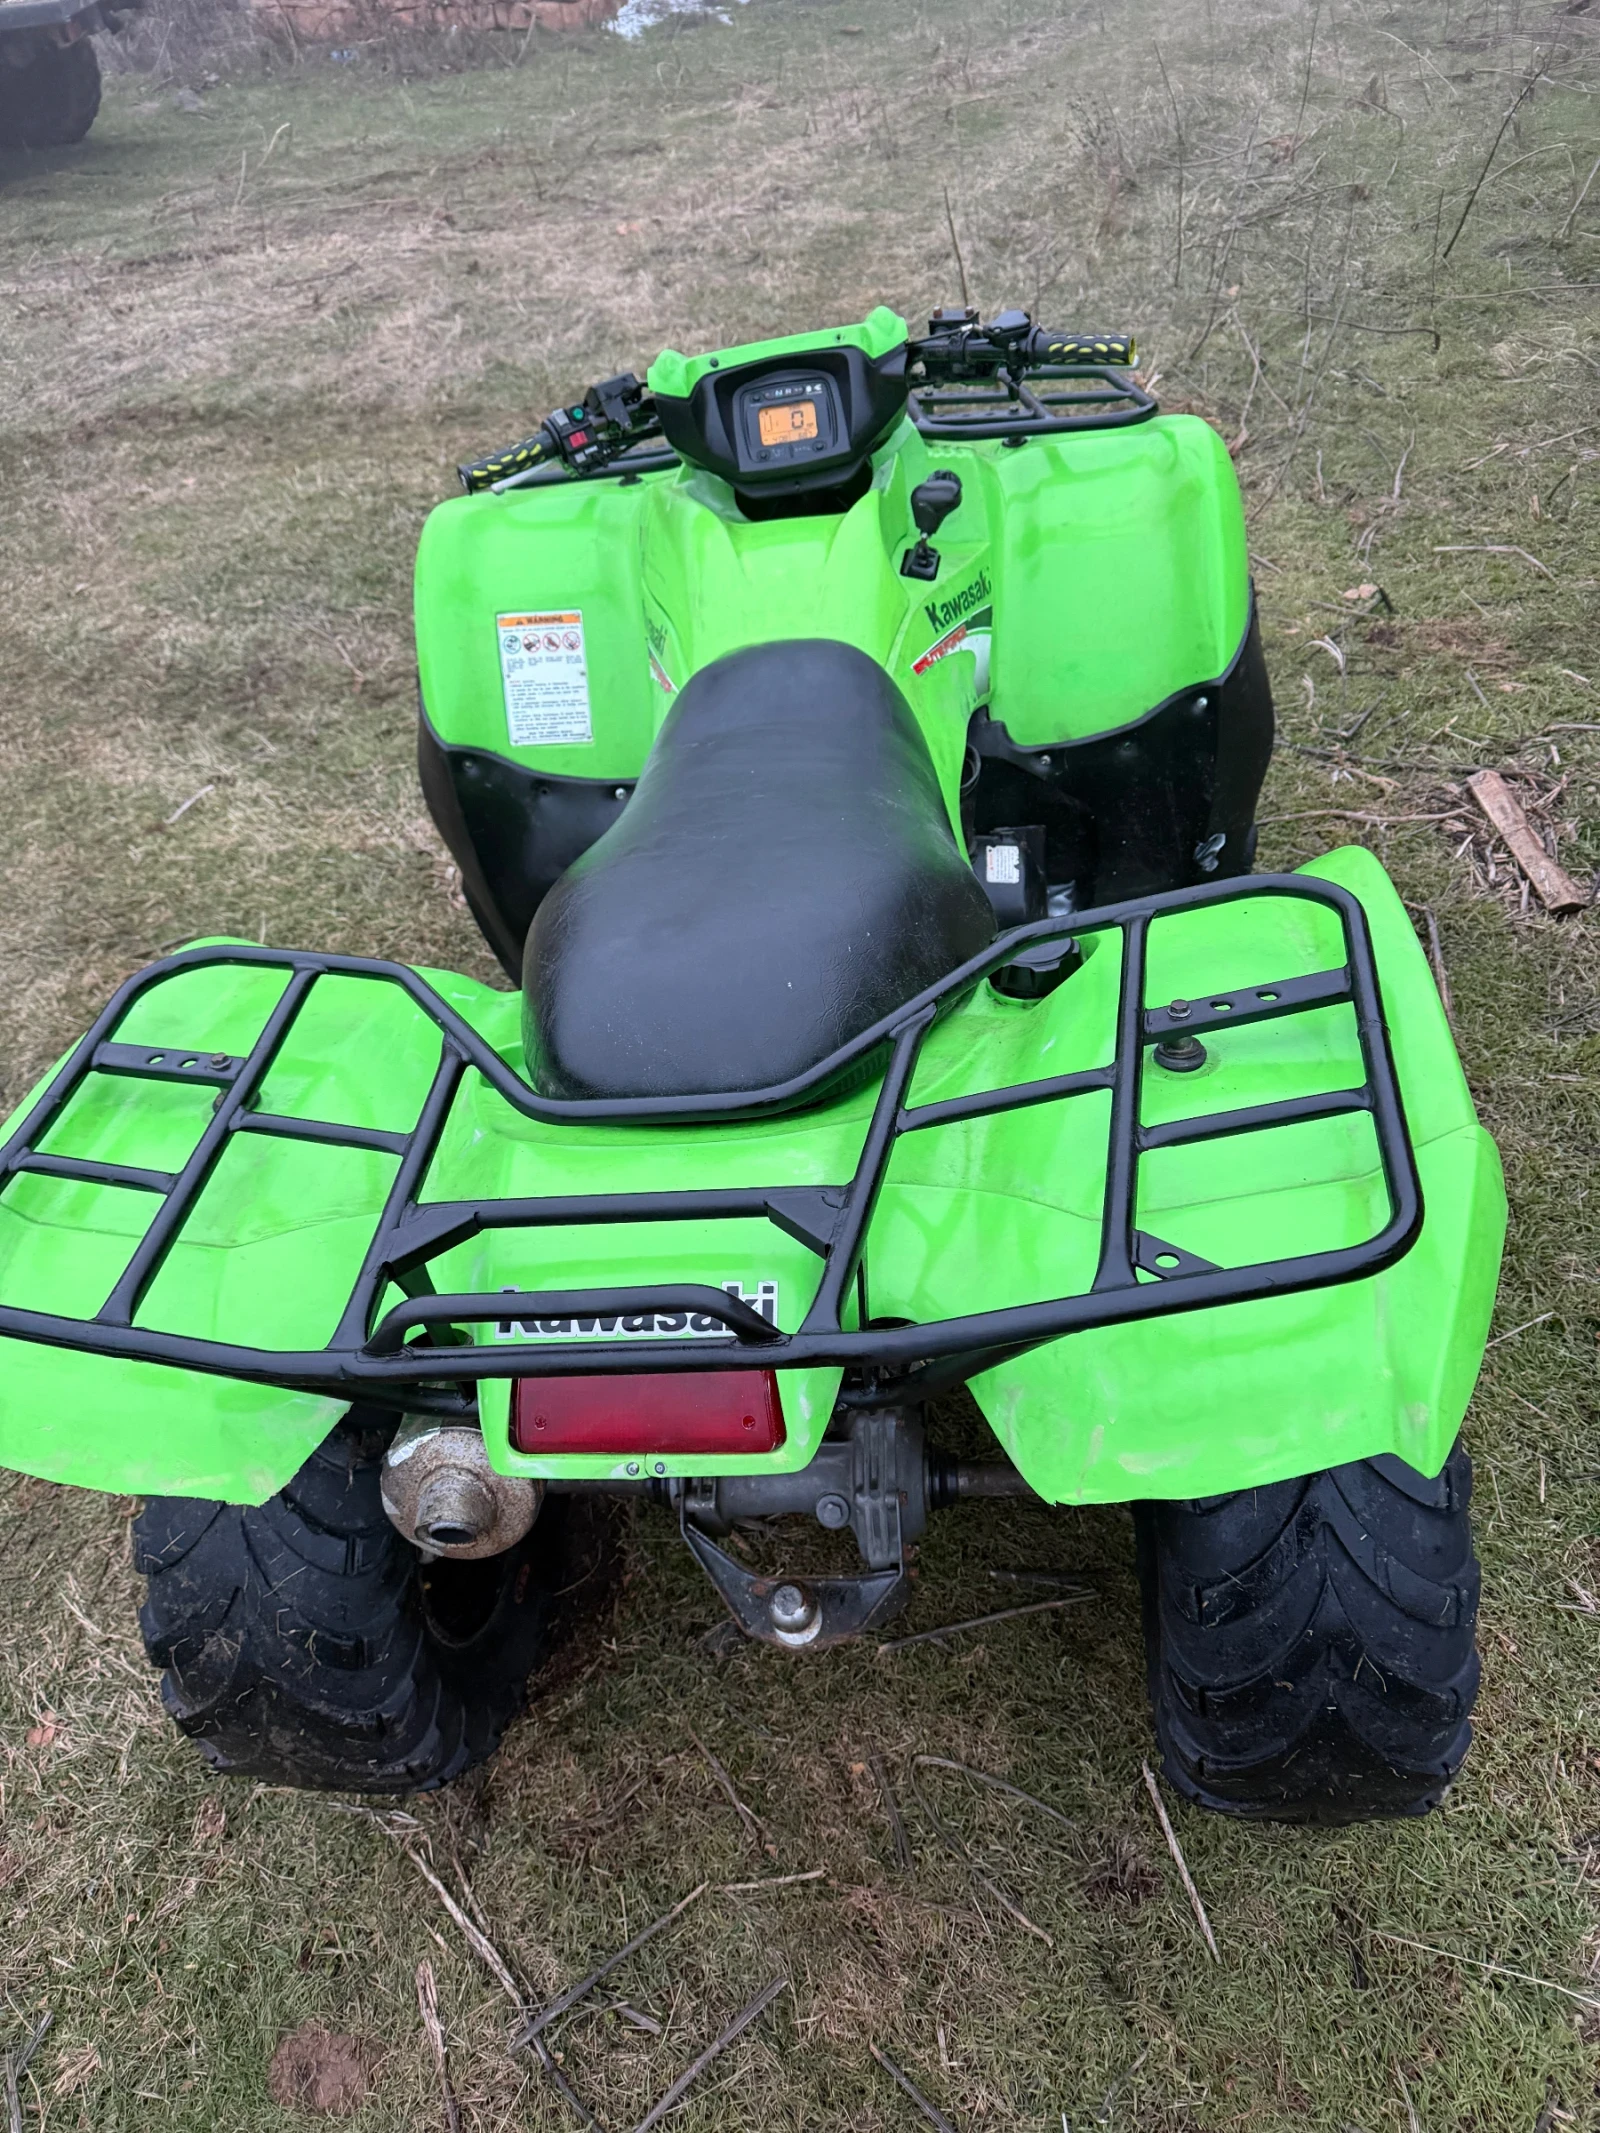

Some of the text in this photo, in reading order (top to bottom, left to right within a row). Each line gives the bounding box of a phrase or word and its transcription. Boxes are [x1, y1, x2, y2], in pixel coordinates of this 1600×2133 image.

[775, 389, 783, 397] N
[791, 411, 804, 429] 0
[526, 614, 564, 624] WARNING
[498, 1284, 775, 1335] asai
